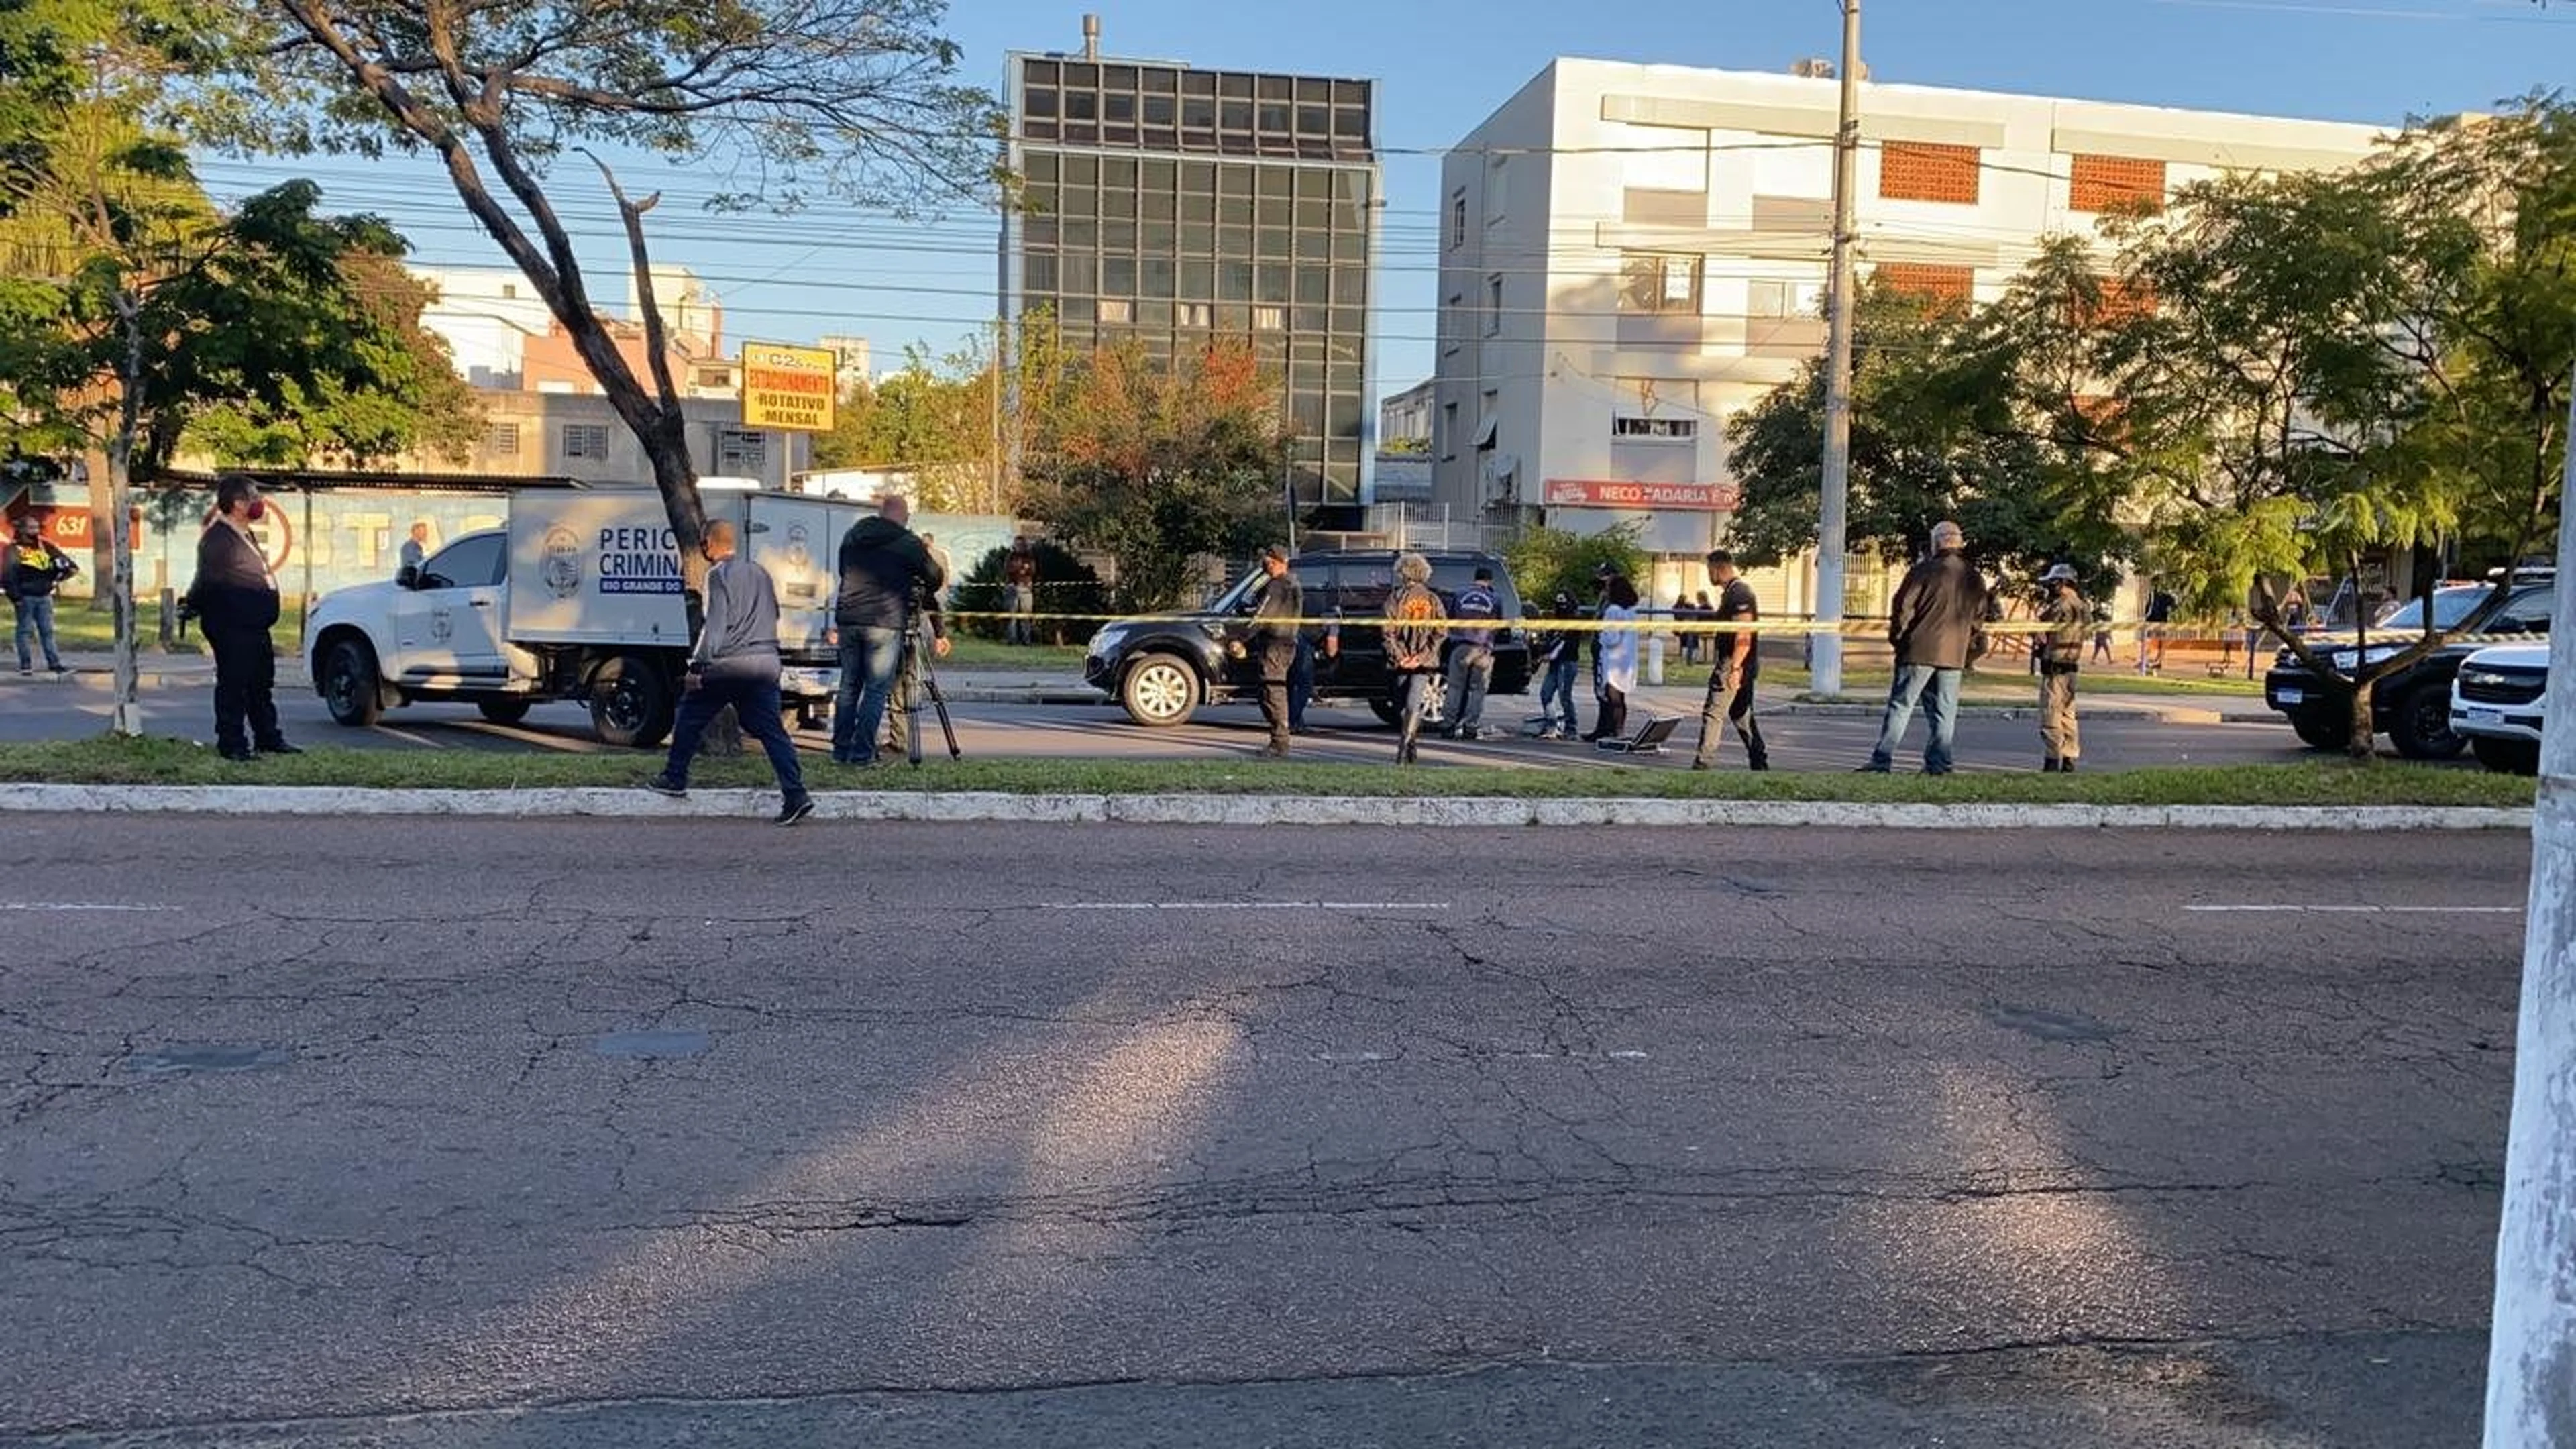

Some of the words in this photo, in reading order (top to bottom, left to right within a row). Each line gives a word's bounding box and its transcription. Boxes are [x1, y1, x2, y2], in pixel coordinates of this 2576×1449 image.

[758, 392, 824, 411] ROTATIVO
[765, 409, 818, 425] MENSAL
[56, 515, 86, 535] 631
[600, 528, 676, 550] PERIC
[599, 553, 679, 576] CRIMIN
